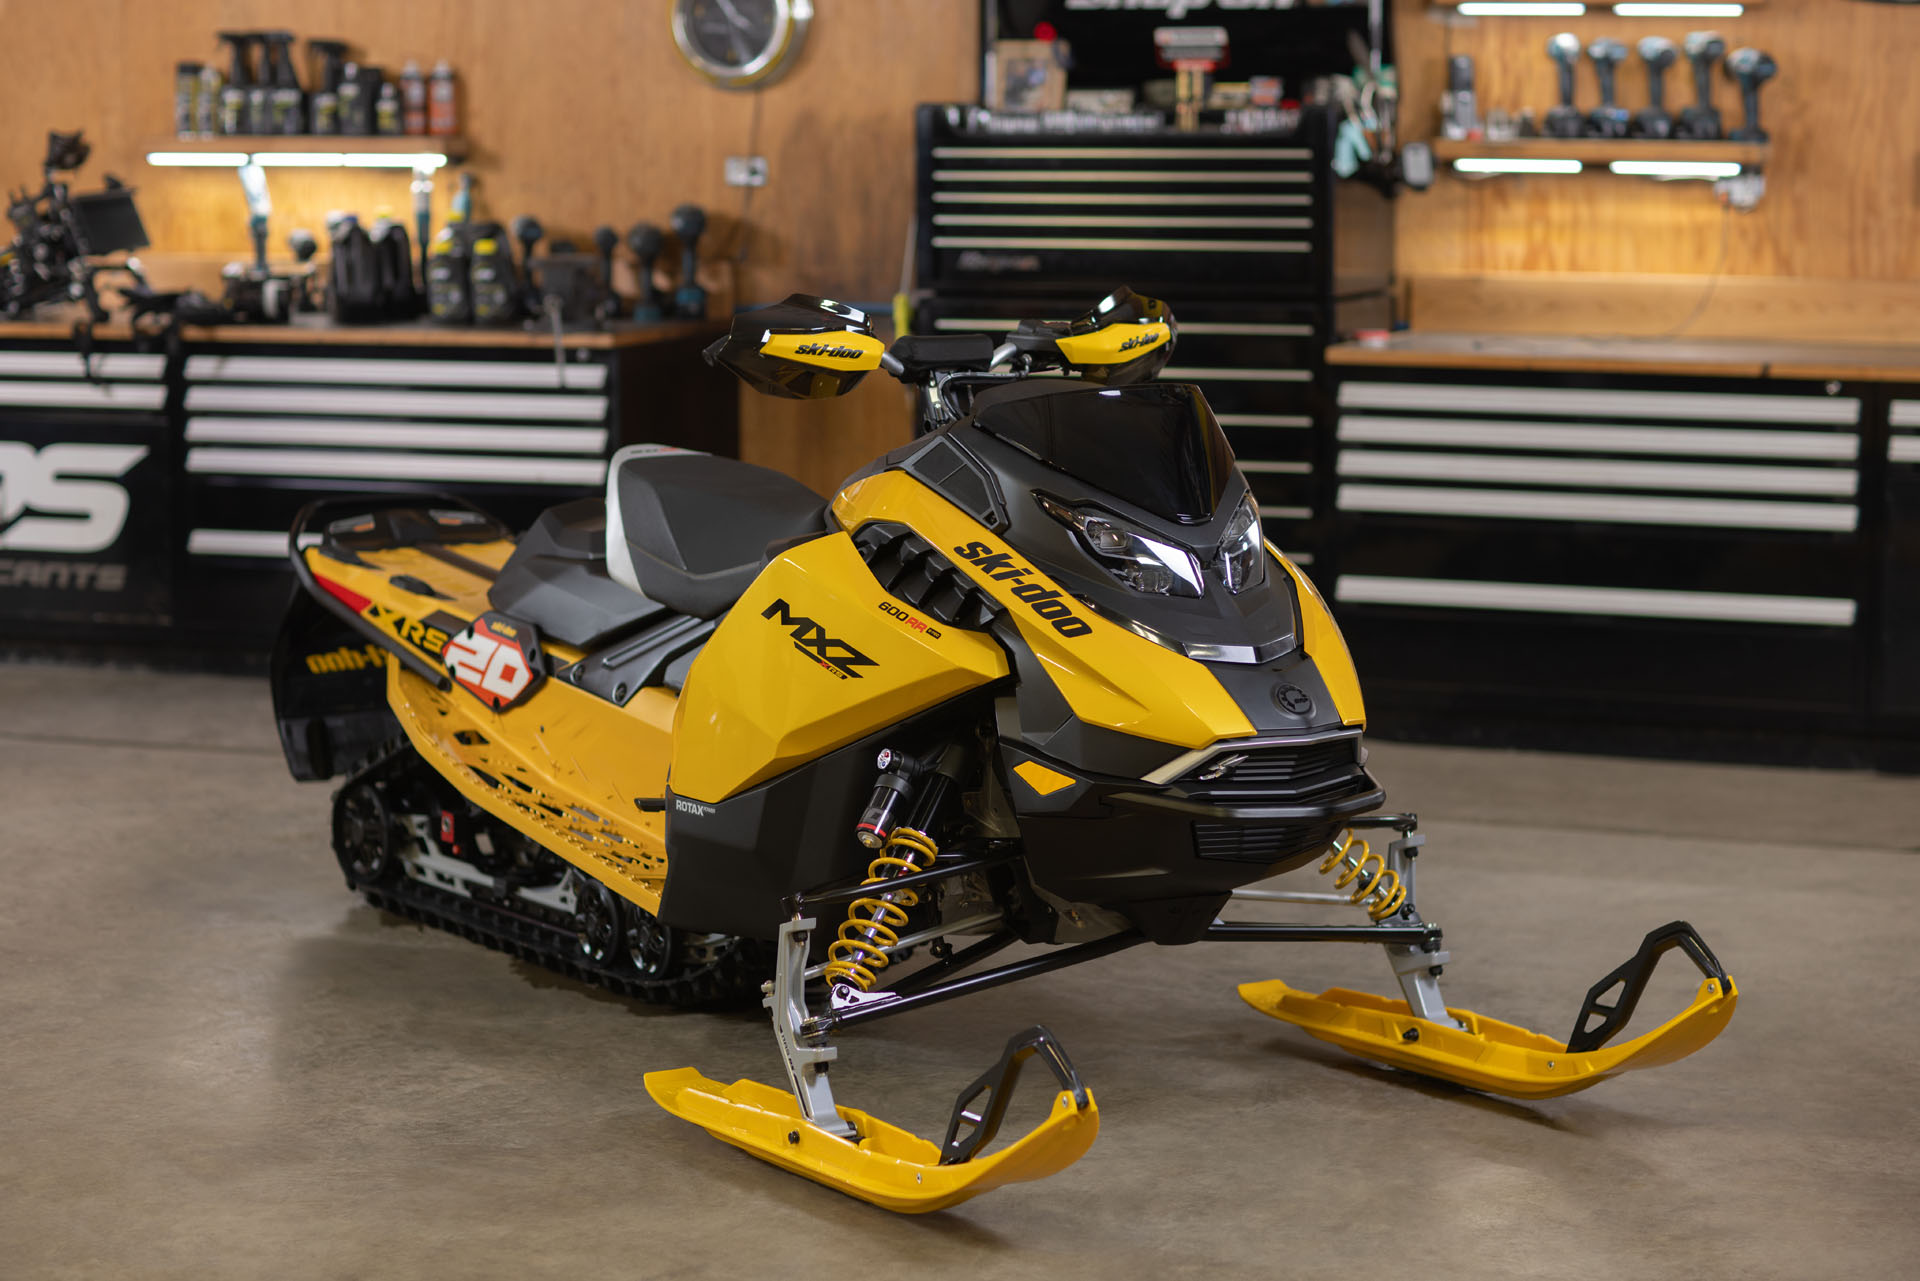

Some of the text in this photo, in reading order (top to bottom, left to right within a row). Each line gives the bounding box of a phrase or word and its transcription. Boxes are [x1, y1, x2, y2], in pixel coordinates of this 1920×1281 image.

[795, 343, 864, 359] ski-doo
[953, 541, 1093, 638] ski-doo
[445, 628, 533, 700] 20
[761, 598, 880, 679] MXZ
[676, 800, 703, 816] ROTAX
